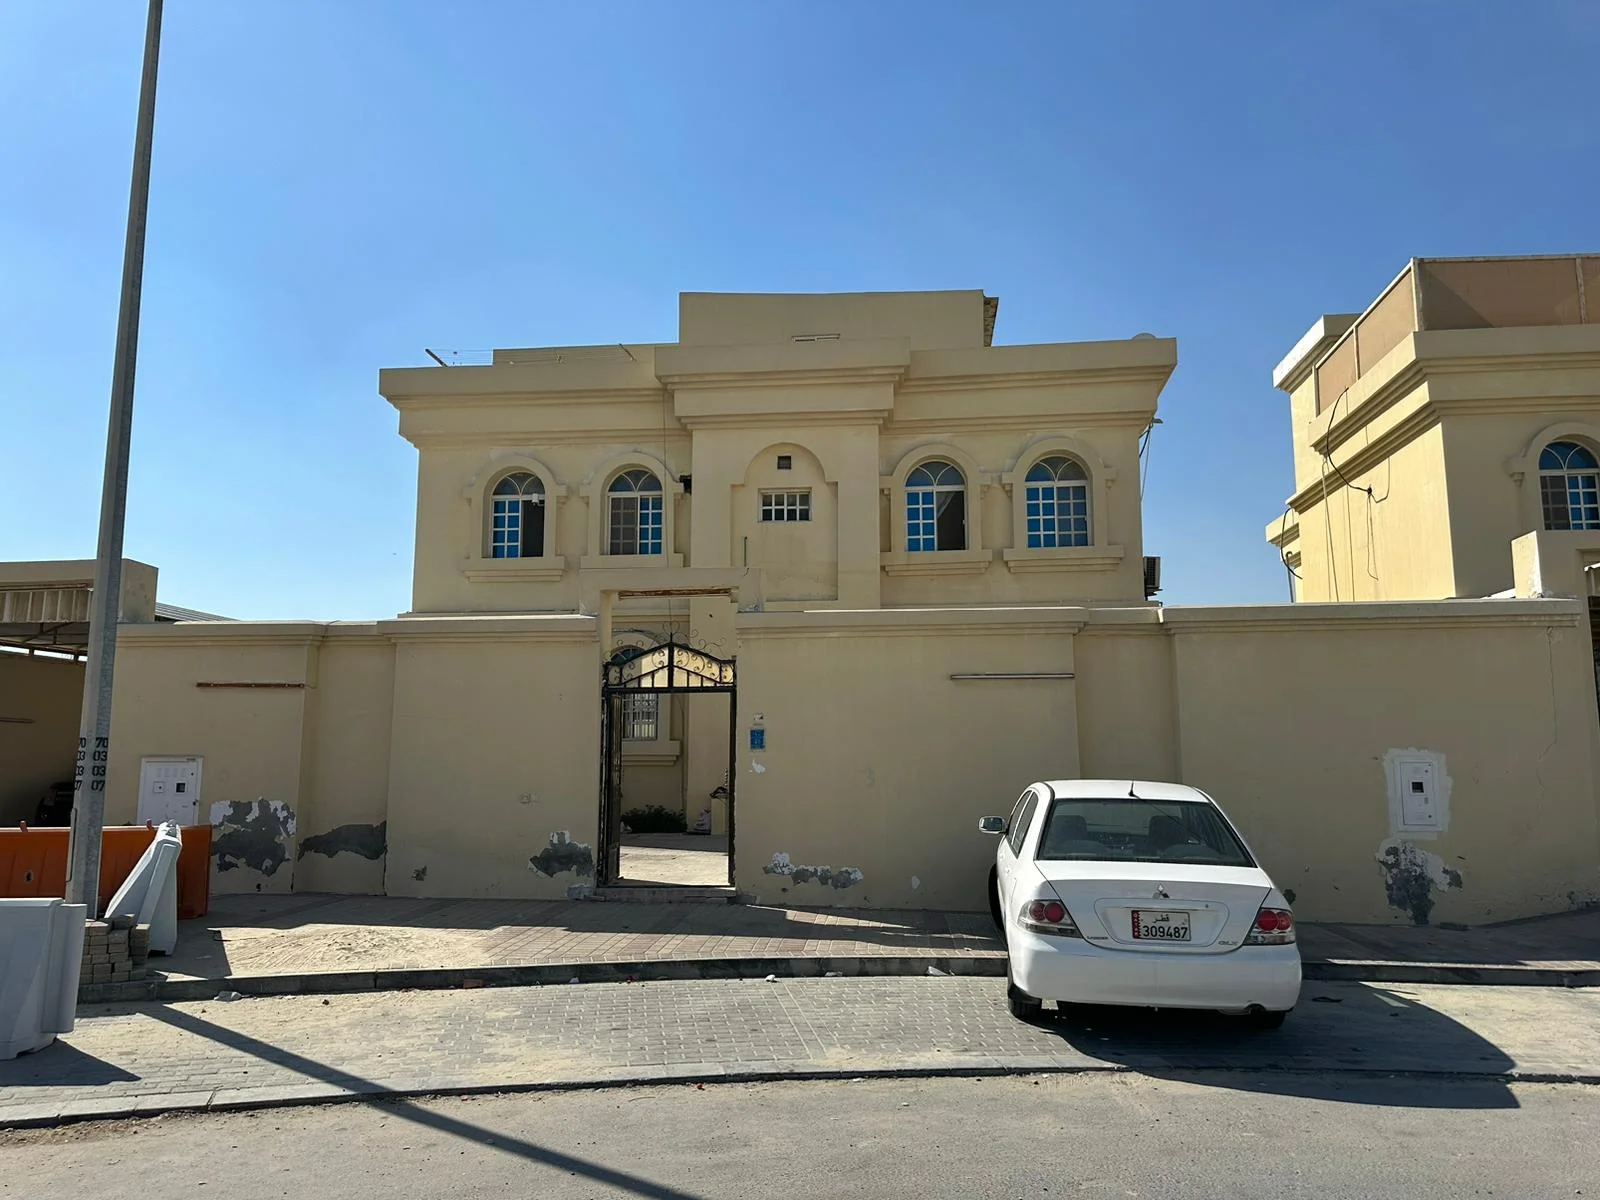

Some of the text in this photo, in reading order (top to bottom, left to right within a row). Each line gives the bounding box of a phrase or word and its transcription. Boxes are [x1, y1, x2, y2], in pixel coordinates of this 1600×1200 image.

[80, 737, 86, 748] 0
[96, 737, 108, 748] 70
[93, 750, 107, 761] 03
[92, 765, 106, 776] 03
[91, 780, 105, 792] 07
[1152, 913, 1170, 924] قطر
[1142, 925, 1188, 939] 309487
